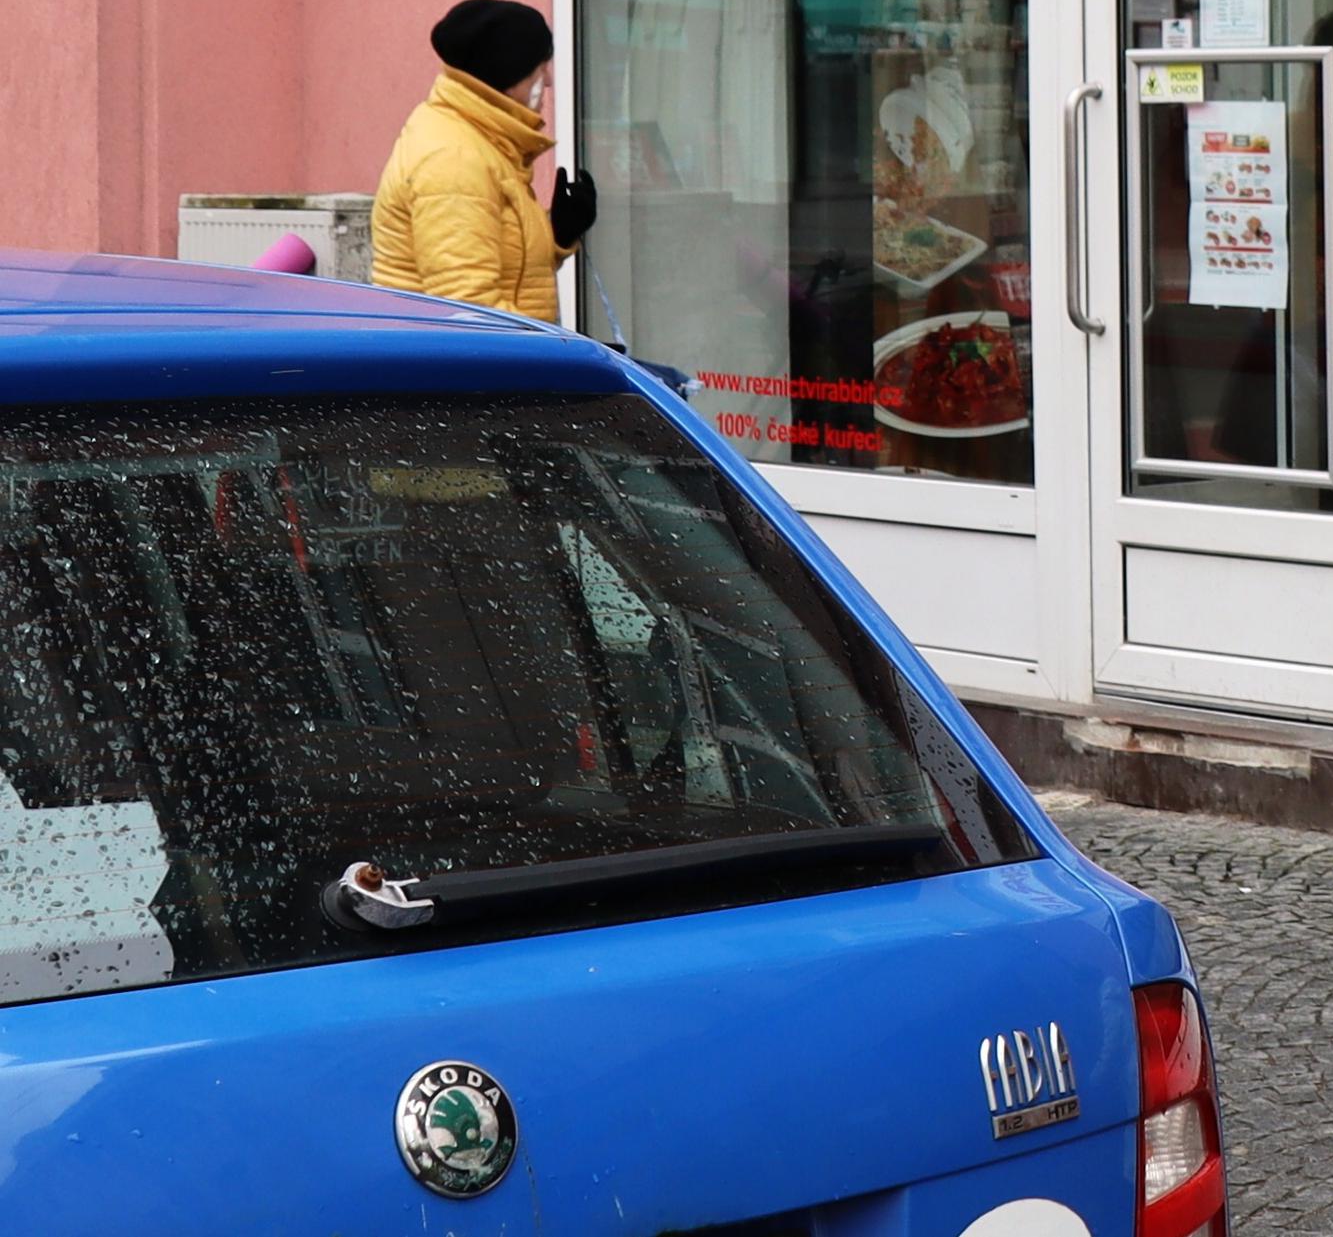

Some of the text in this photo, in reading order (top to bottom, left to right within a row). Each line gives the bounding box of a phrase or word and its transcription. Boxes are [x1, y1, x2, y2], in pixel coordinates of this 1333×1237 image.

[697, 370, 904, 407] www.reznictvirabbit.cz
[716, 411, 884, 452] 100% české kuřecí
[980, 1021, 1076, 1112] FABIA
[1002, 1100, 1078, 1132] 1.2 HTP
